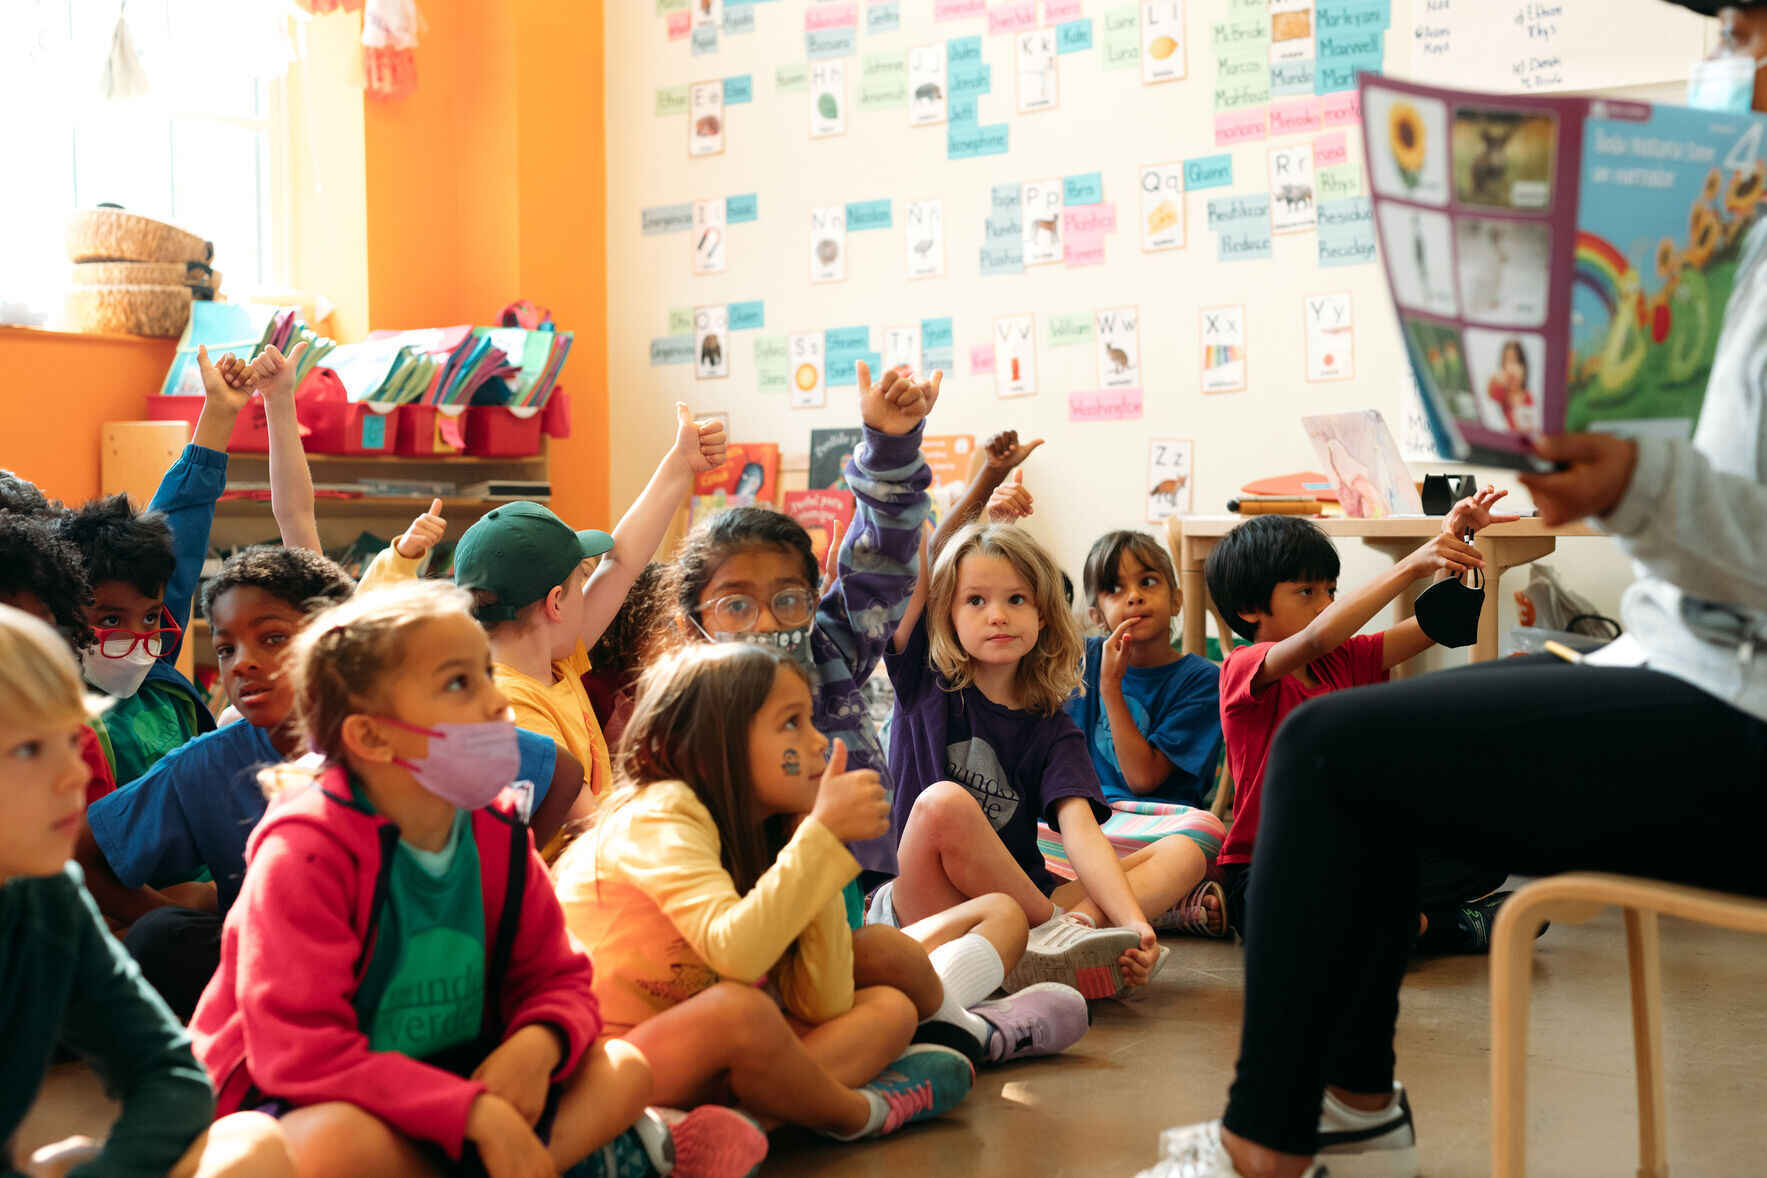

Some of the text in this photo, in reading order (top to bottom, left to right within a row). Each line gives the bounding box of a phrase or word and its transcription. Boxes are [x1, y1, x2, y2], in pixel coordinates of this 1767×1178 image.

[1147, 6, 1160, 26] L
[1276, 154, 1291, 176] R
[1141, 170, 1161, 193] Q
[1309, 300, 1326, 321] Y
[1097, 313, 1117, 335] W
[1205, 312, 1220, 335] X
[1155, 445, 1168, 467] Z
